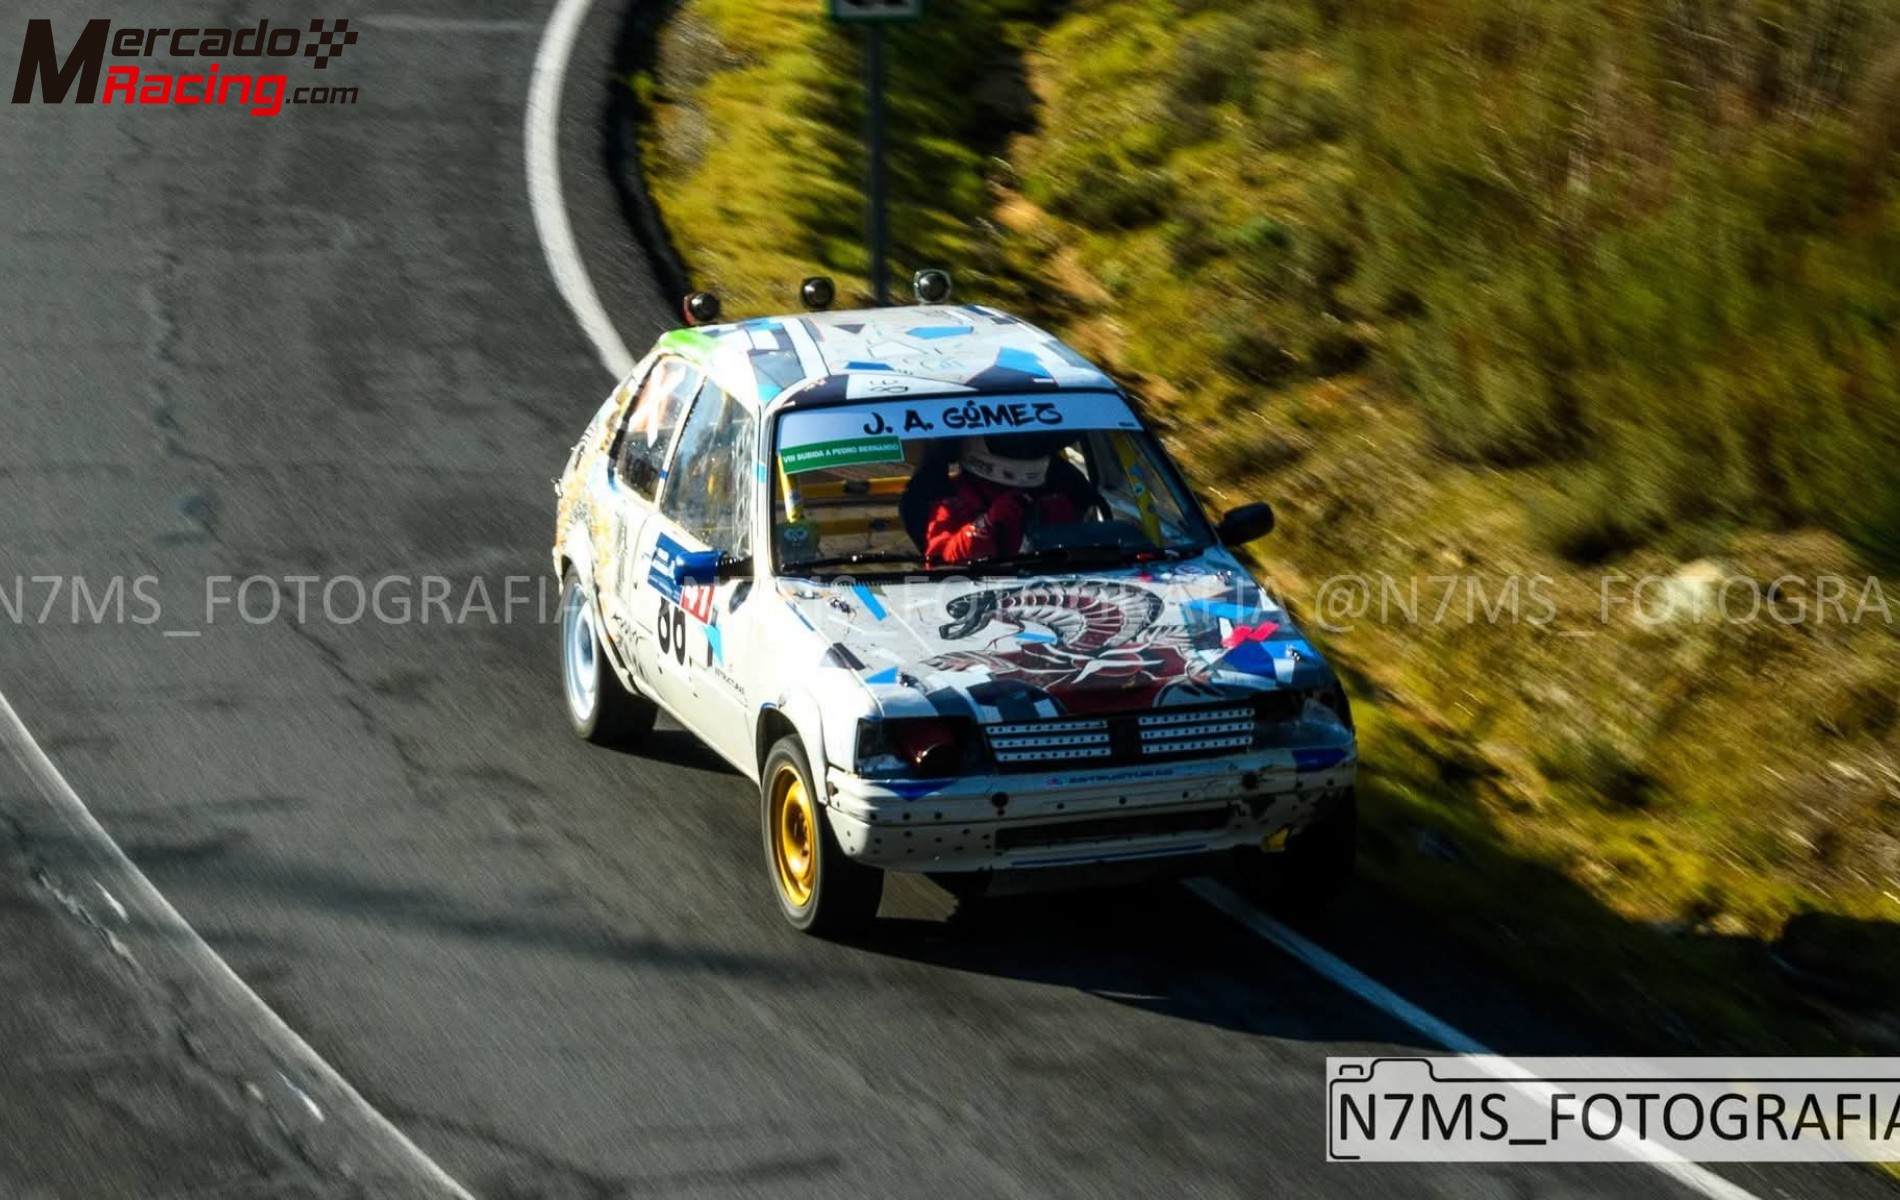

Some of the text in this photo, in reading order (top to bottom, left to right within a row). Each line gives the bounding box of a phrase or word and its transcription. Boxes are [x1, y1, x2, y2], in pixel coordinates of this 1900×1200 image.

[863, 411, 893, 436] J.
[903, 409, 935, 432] A.
[796, 449, 824, 462] SUBIDA
[832, 446, 858, 456] PEDRO
[858, 442, 899, 454] BERNARDO
